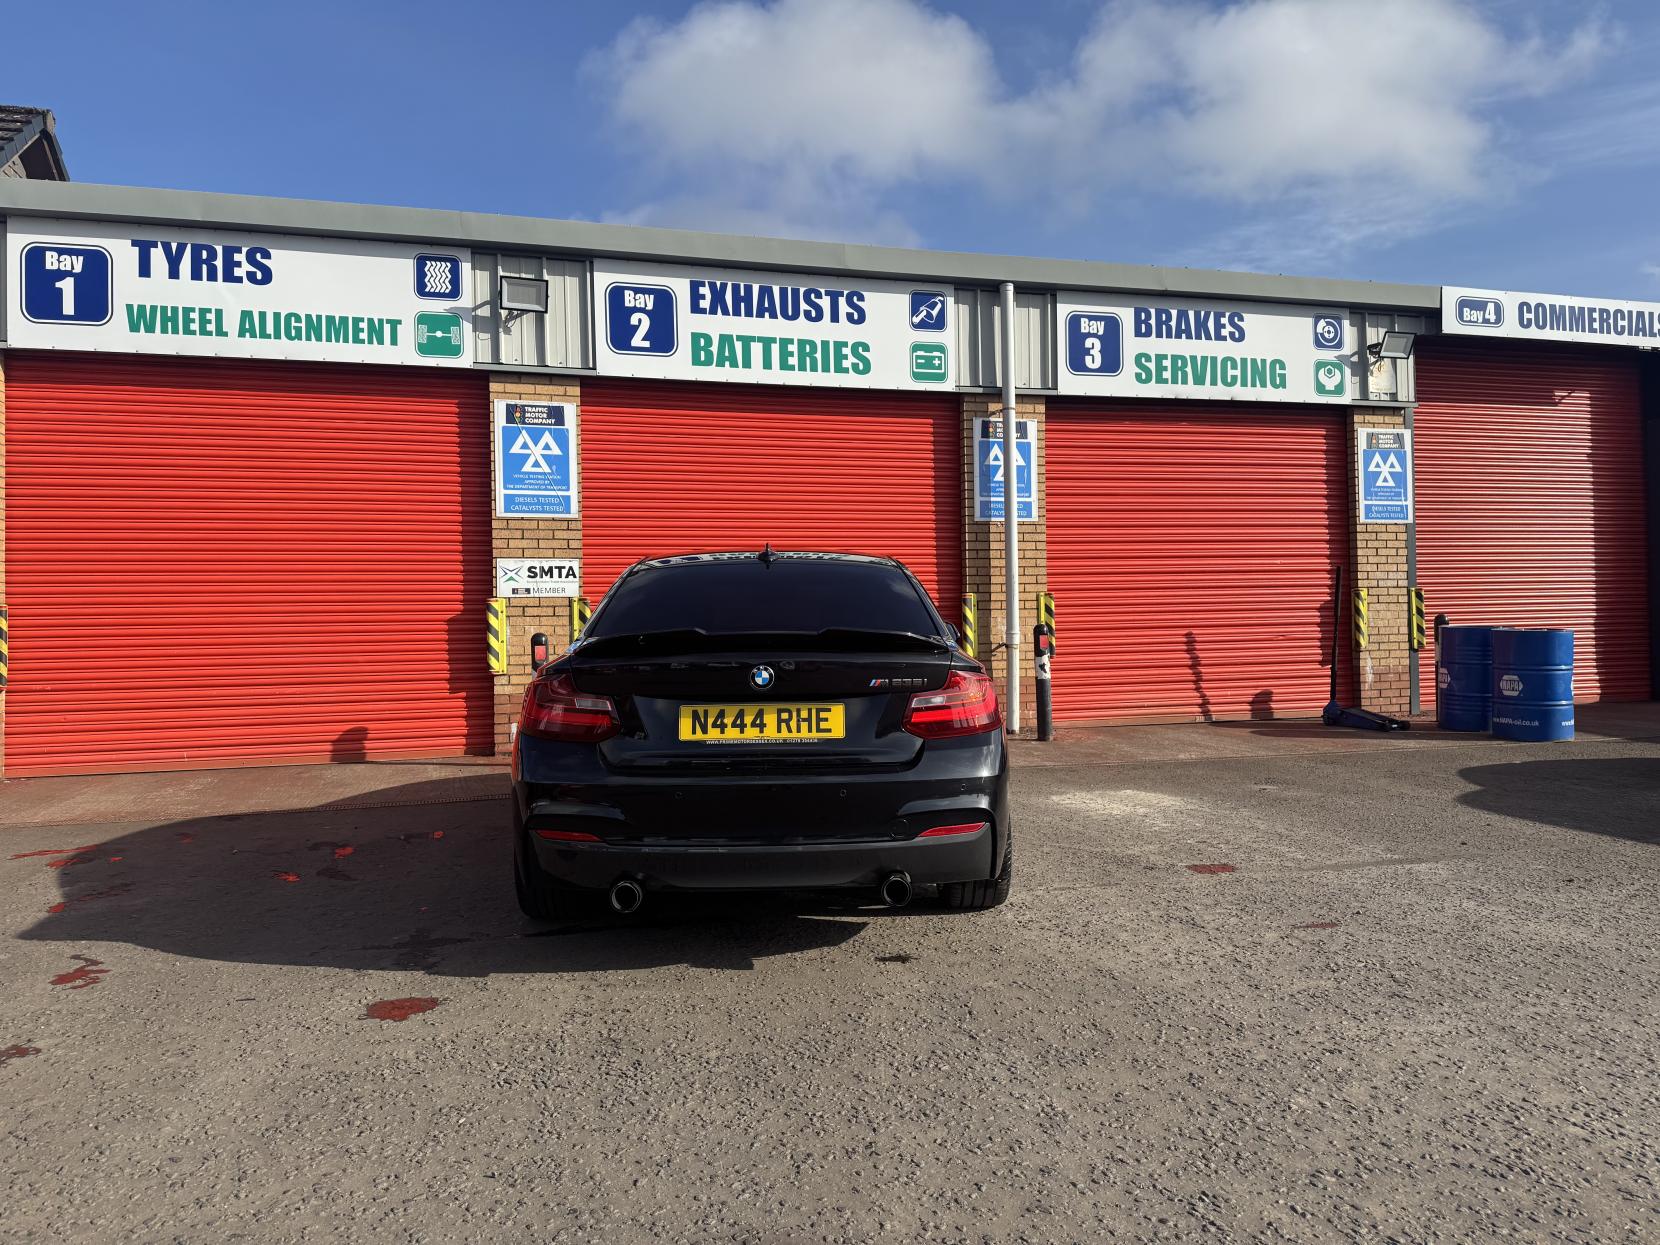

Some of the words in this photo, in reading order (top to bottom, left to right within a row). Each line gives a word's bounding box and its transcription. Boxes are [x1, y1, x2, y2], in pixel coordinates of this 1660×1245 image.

[45, 250, 84, 274] Bay
[131, 239, 273, 285] TYRES
[54, 276, 75, 316] 1
[624, 289, 655, 310] Bay
[689, 279, 867, 325] EXHAUSTS
[1463, 307, 1484, 323] Bay
[1484, 302, 1496, 323] 4
[125, 303, 228, 338] WHEEL
[237, 309, 402, 347] ALIGNMENT
[630, 312, 651, 348] 2
[1080, 317, 1105, 336] Bay
[1133, 306, 1246, 343] BRAKES
[1517, 301, 1660, 338] COMMERCIAL
[690, 331, 872, 376] BATTERIES
[1084, 337, 1102, 369] 3
[1134, 352, 1287, 390] SERVICING
[527, 565, 577, 579] SMTA
[1502, 680, 1519, 691] NAPA
[691, 708, 767, 735] N444
[776, 707, 832, 734] RHE
